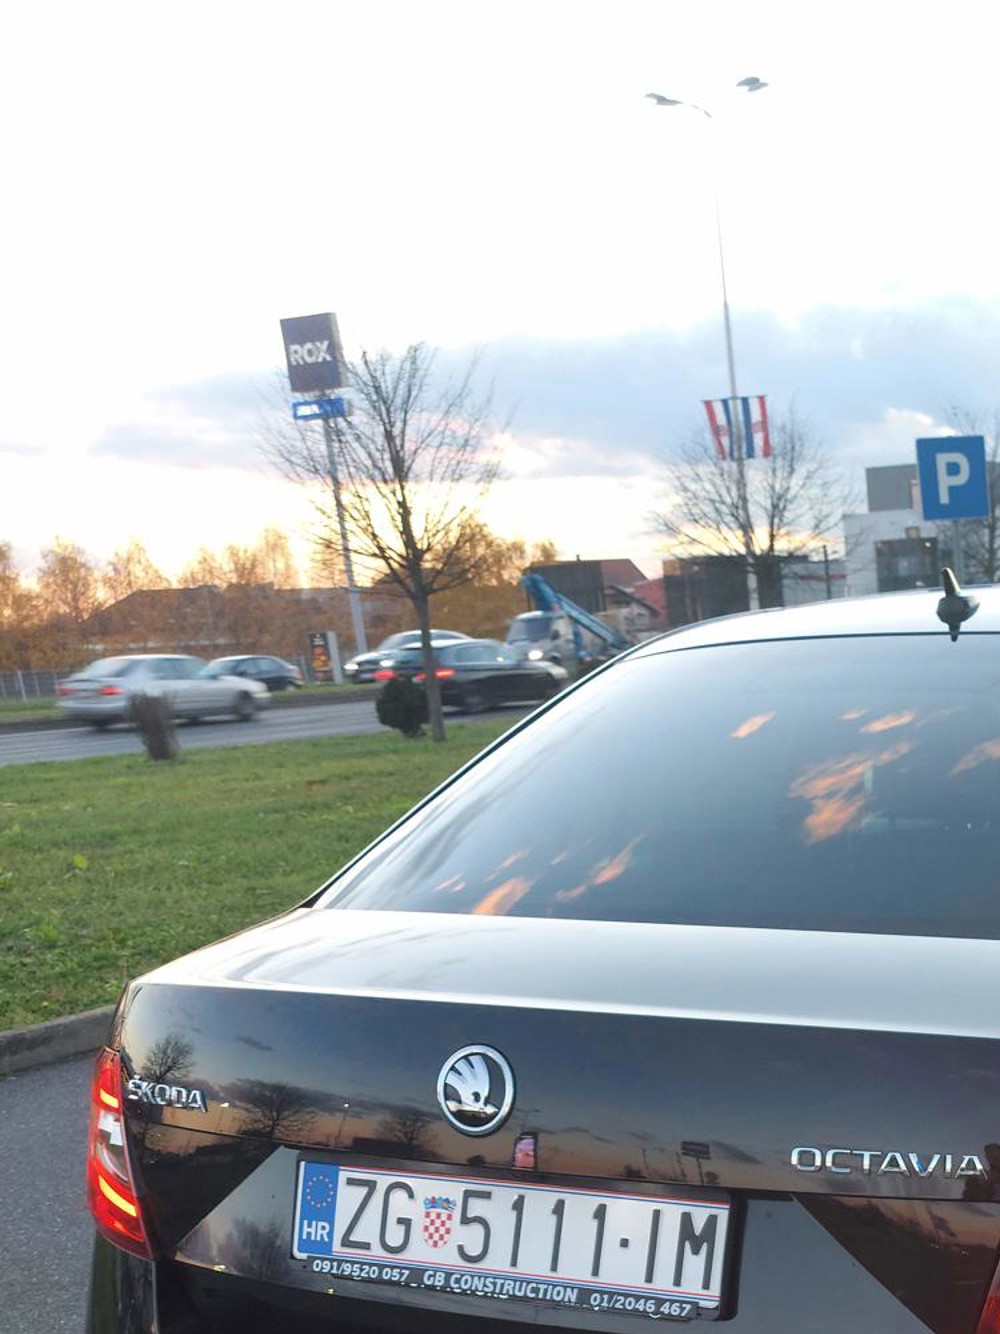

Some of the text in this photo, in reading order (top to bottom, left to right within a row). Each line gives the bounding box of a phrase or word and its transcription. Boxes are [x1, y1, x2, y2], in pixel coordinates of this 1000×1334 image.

[289, 340, 332, 365] ROX
[935, 452, 970, 505] P
[127, 1074, 208, 1113] ŠKODA
[790, 1146, 989, 1181] OCTAVIA
[302, 1219, 330, 1242] HR
[340, 1177, 415, 1254] ZG
[312, 1259, 692, 1317] 091/9520 057 GB CONSTRUCTION 01/2046 467
